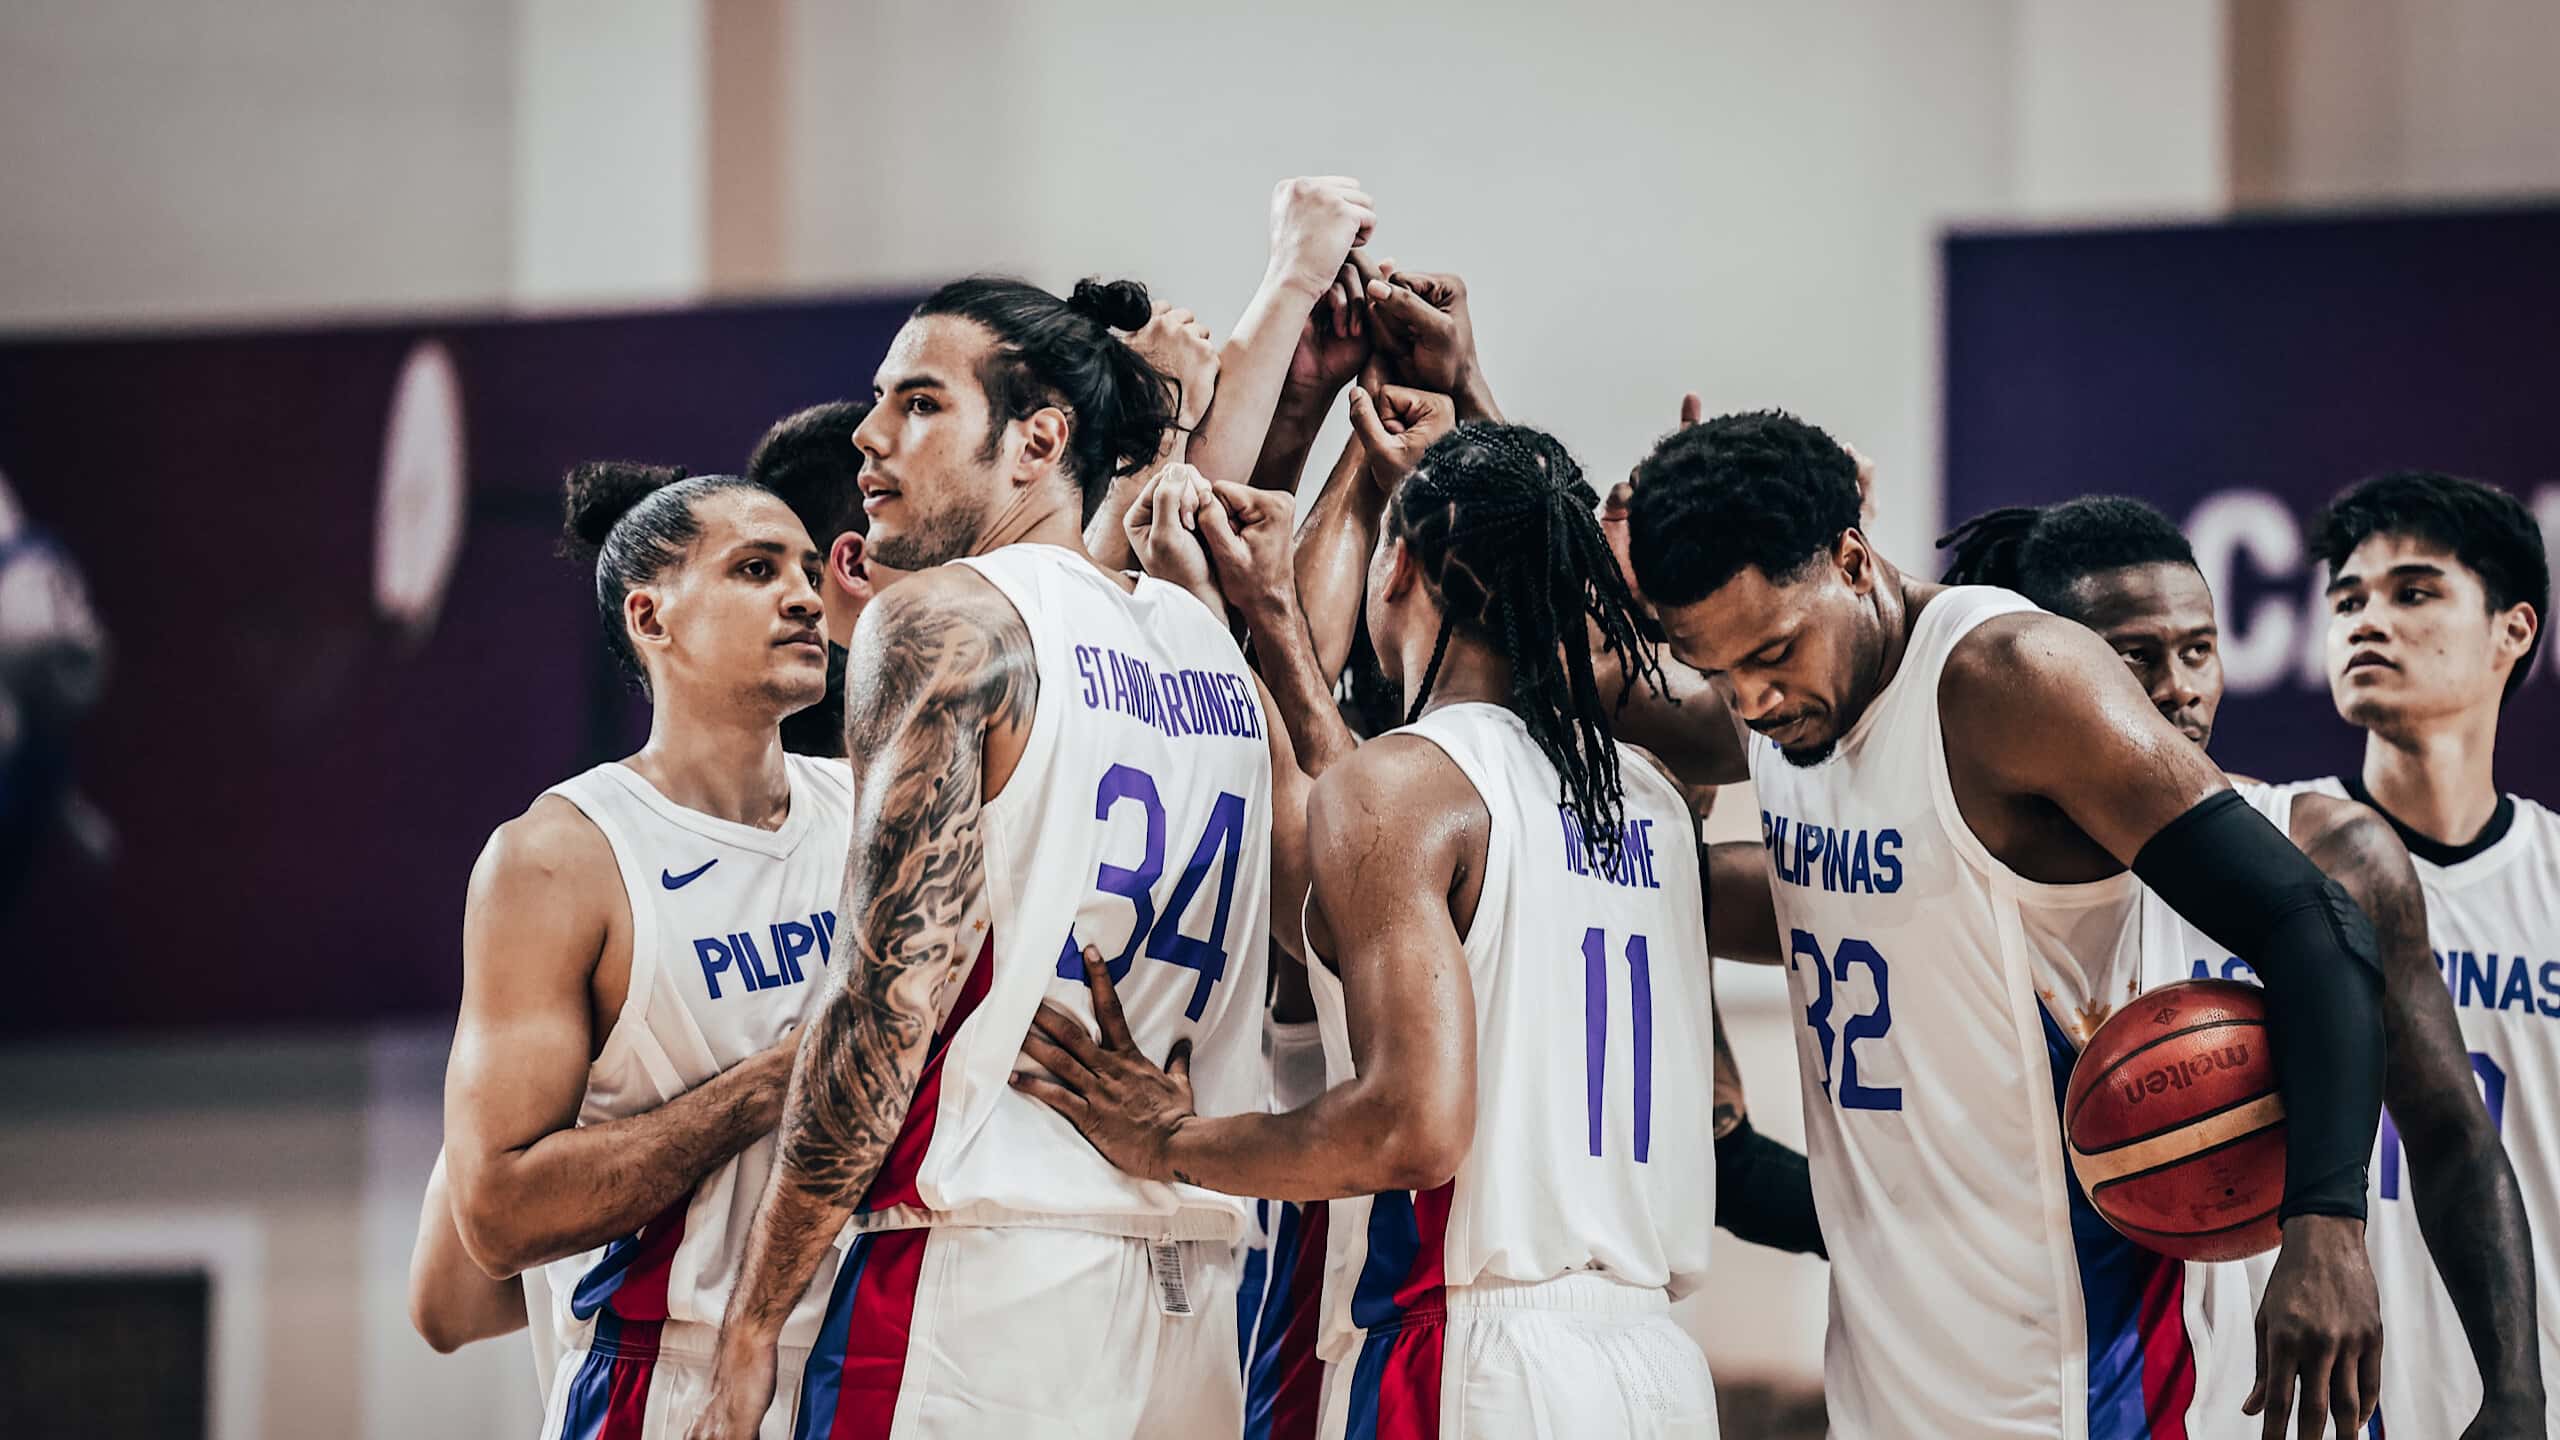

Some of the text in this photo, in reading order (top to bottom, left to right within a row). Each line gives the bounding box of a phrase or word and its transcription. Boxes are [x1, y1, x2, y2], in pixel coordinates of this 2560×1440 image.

[693, 910, 836, 999] PILIPI
[1057, 762, 1247, 1022] 34
[1581, 927, 1652, 1163] 11
[1791, 928, 1903, 1111] 32
[2432, 951, 2560, 1018] INAS
[2124, 1044, 2249, 1104] molten
